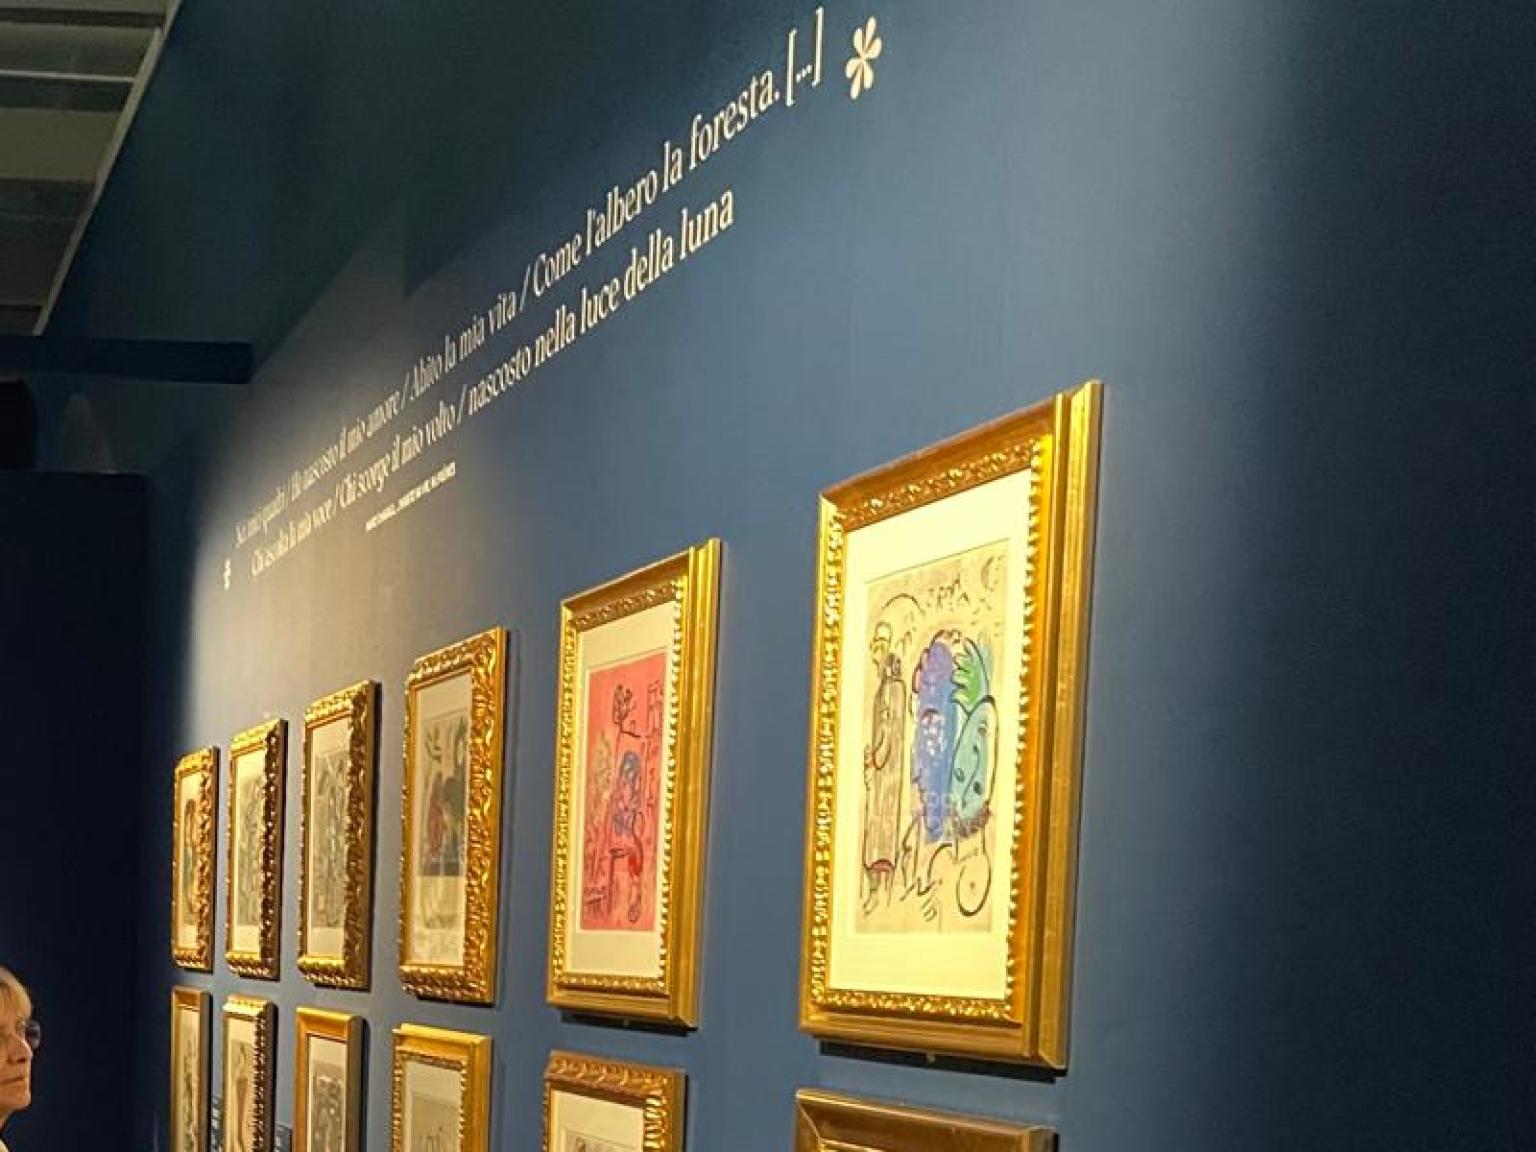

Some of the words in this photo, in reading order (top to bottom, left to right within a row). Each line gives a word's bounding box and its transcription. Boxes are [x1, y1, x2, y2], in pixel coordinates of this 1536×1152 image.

[425, 400, 456, 446] volto
[468, 345, 531, 416] nascosto
[535, 304, 576, 368] nella
[581, 277, 621, 335] luce
[624, 227, 674, 301] della
[680, 188, 734, 260] luna
[445, 335, 456, 373] la
[459, 314, 484, 362] mia
[488, 291, 517, 334] vita
[533, 233, 582, 297] Come
[586, 169, 658, 256] l'albero
[662, 140, 682, 193] la
[689, 69, 780, 171] foresta.
